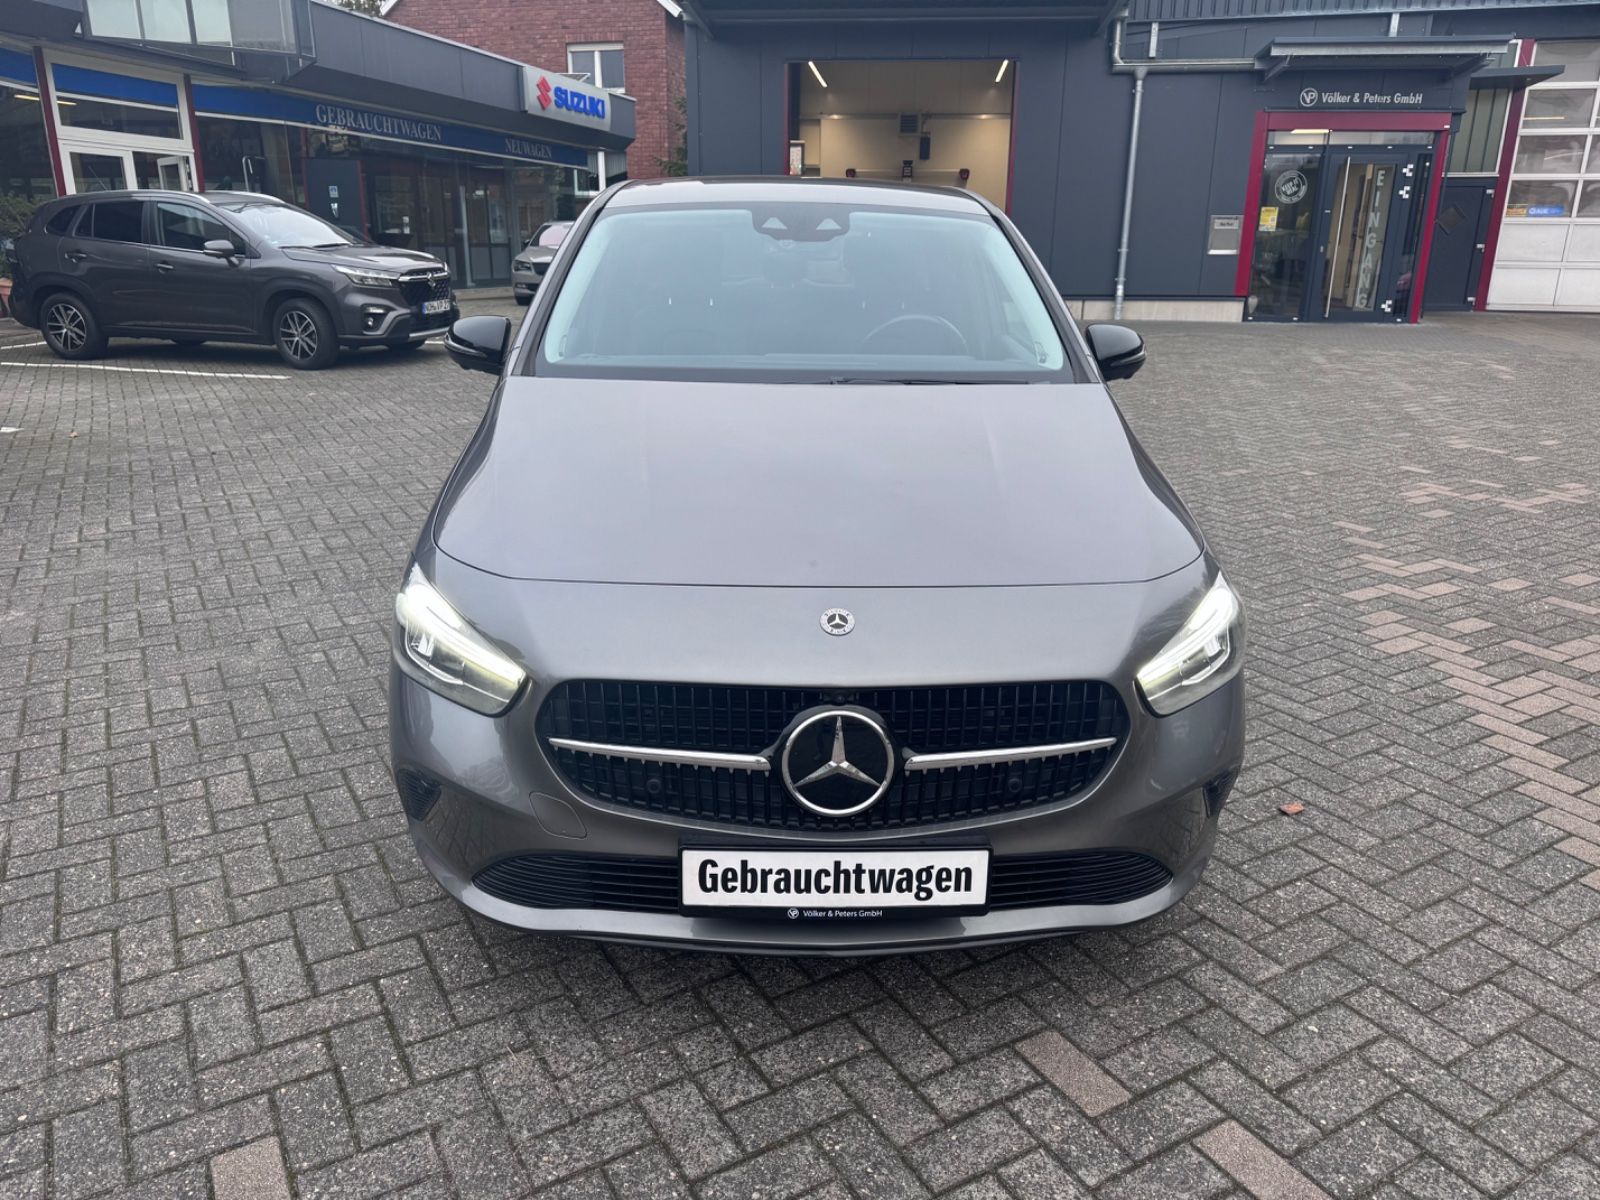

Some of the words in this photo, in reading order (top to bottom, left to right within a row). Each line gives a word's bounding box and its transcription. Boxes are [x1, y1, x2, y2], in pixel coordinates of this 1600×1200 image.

[553, 85, 606, 120] SUZUKI
[1321, 91, 1351, 103] Völker
[1353, 92, 1360, 103] &
[1363, 92, 1392, 103] Peters
[1394, 93, 1423, 104] GmbH
[315, 103, 443, 140] GEBRAUCHTWAGEN
[504, 137, 553, 160] NEUWAGEN
[1358, 169, 1386, 309] EINGANG
[698, 859, 972, 900] Gebrauchtwagen
